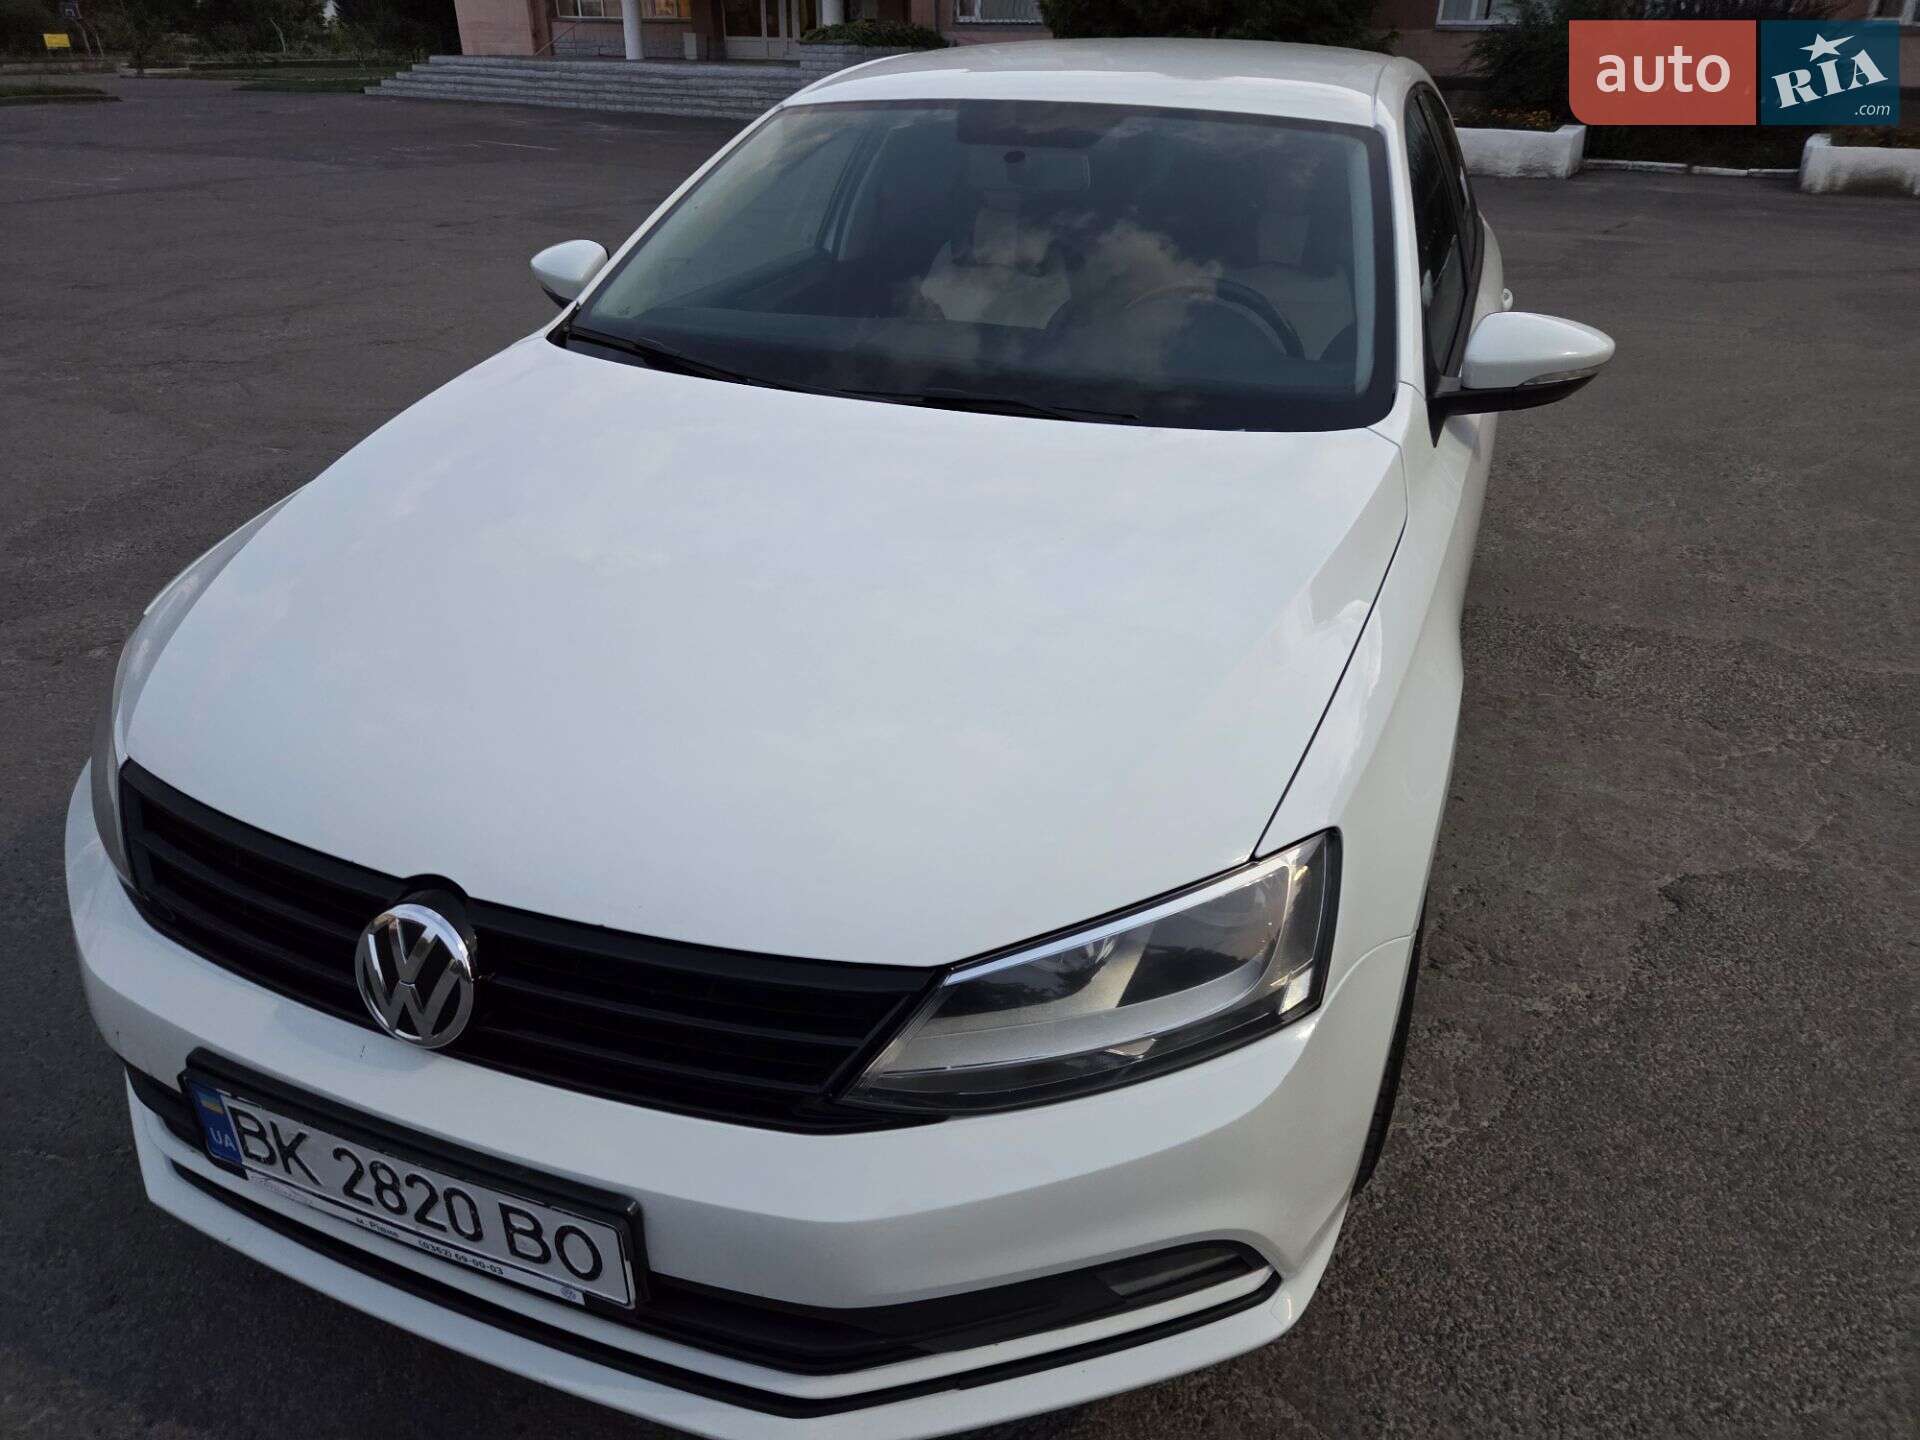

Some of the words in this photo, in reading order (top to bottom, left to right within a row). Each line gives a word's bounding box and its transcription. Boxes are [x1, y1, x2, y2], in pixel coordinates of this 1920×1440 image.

[209, 1127, 237, 1152] UA
[227, 1105, 323, 1186] BK
[332, 1147, 485, 1243] 2820
[498, 1201, 603, 1281] BO
